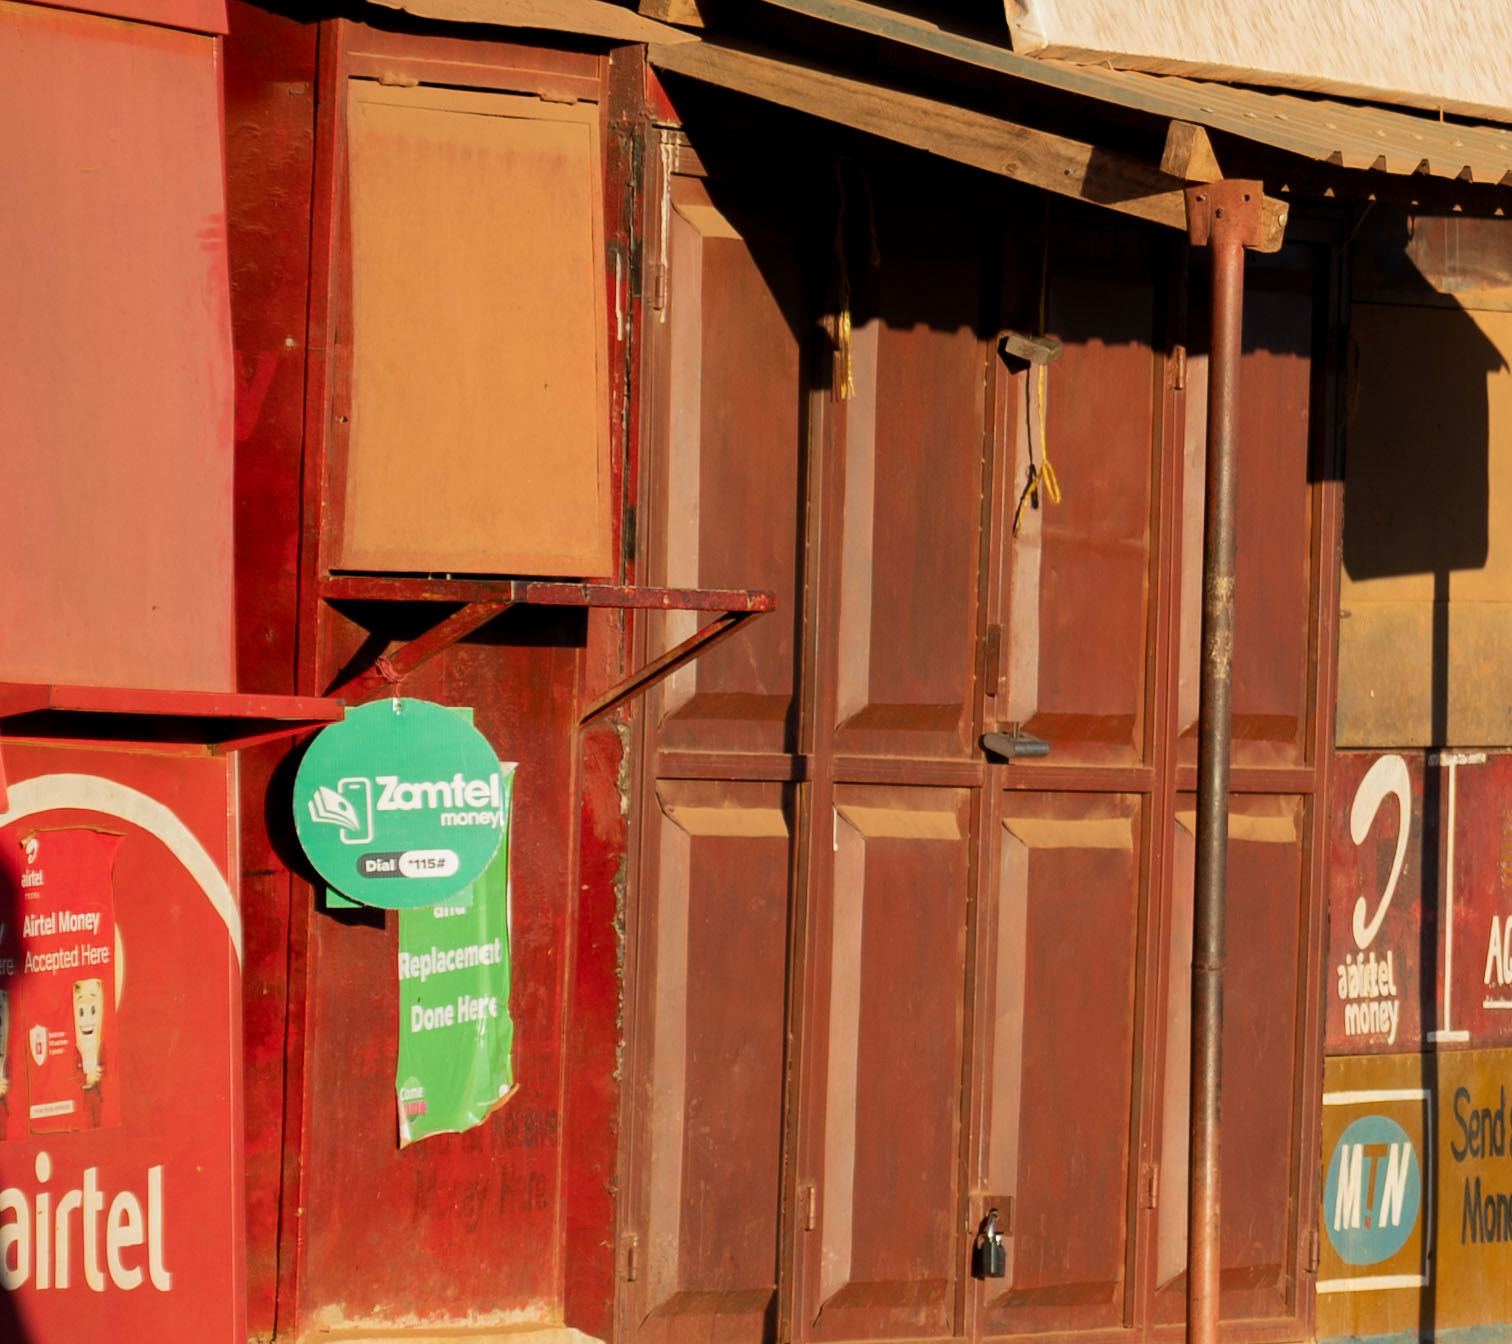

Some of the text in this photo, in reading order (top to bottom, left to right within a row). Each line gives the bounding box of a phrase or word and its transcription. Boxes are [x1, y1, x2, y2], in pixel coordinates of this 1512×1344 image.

[376, 773, 500, 810] Zamtel
[21, 868, 43, 888] airtel
[365, 859, 396, 872] Dial
[23, 913, 56, 938] Airtel
[58, 910, 100, 935] Money
[24, 943, 110, 976] Accepted Here
[399, 938, 501, 982] Replacement
[411, 995, 497, 1033] Done Here
[1345, 999, 1400, 1047] money
[1451, 1085, 1505, 1163] Send
[1334, 1142, 1411, 1231] MTN
[0, 1151, 172, 1292] airtel
